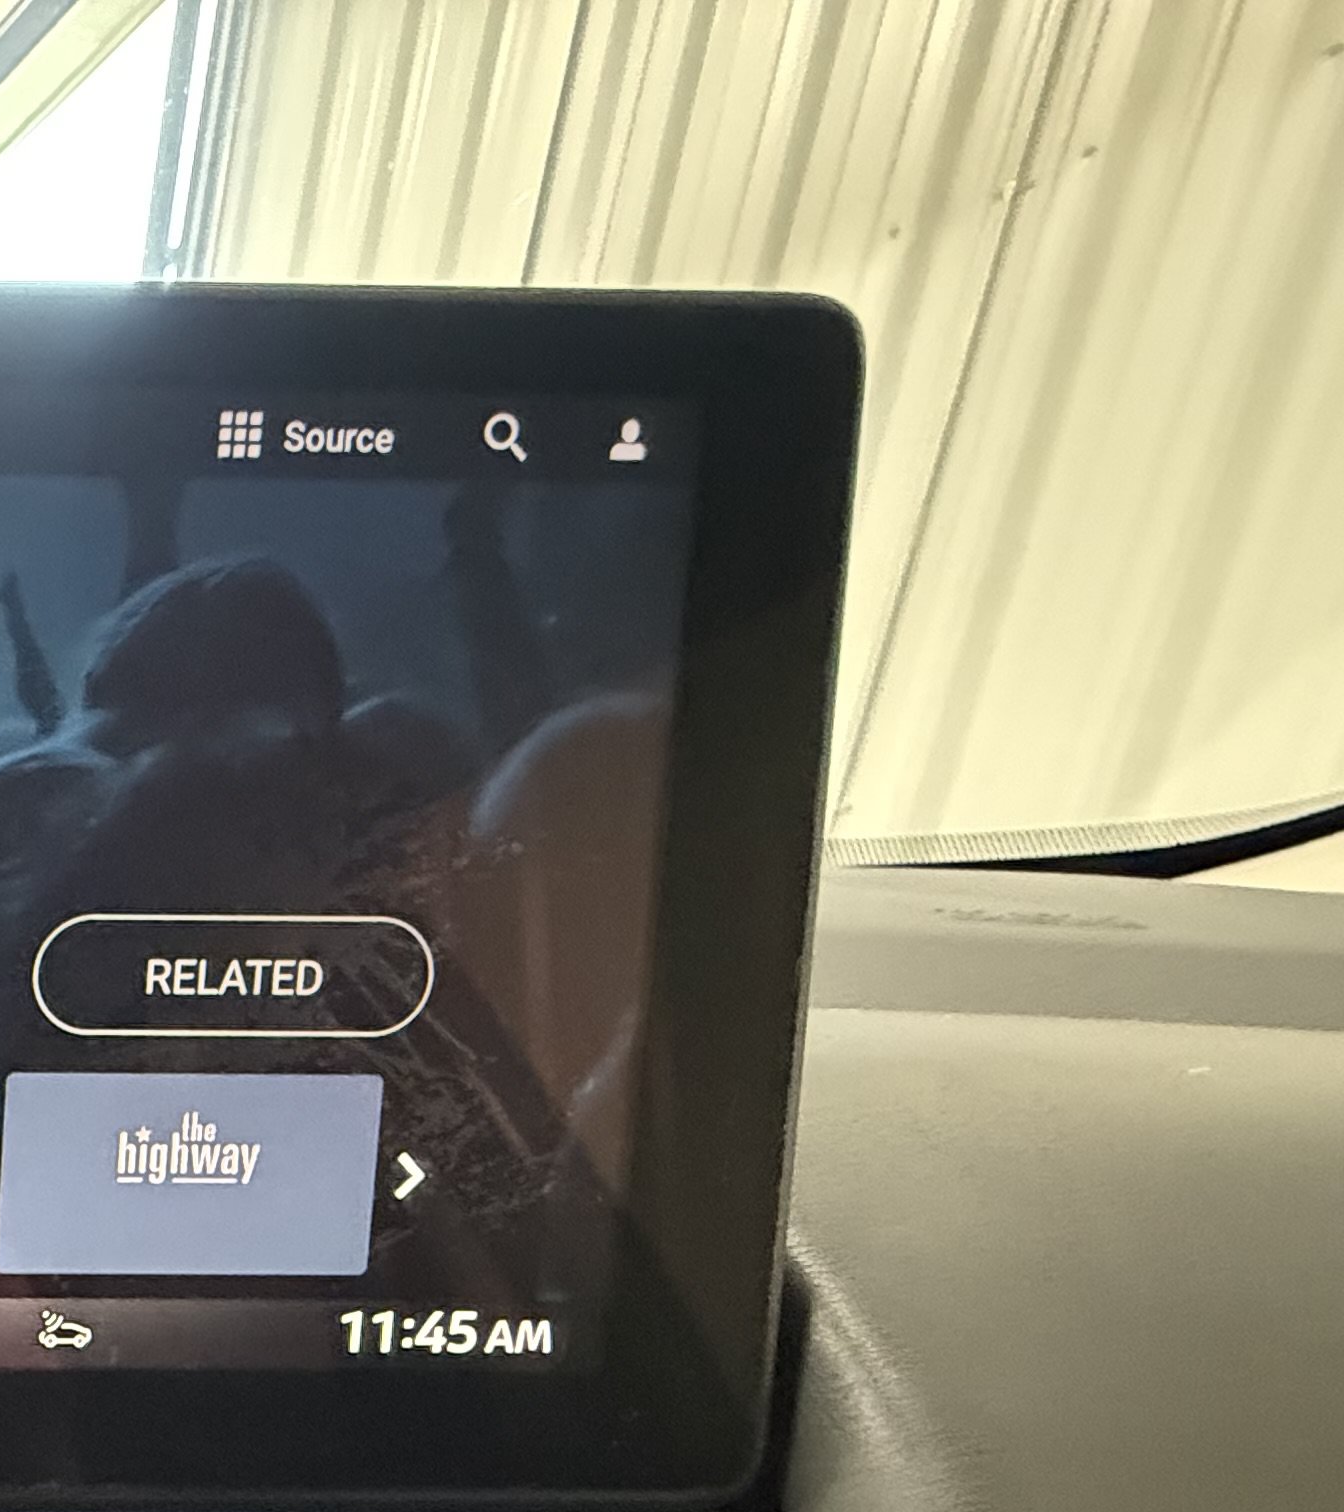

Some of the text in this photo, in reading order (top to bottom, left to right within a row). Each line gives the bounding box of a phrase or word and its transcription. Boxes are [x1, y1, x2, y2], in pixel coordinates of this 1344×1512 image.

[283, 420, 395, 454] Source
[143, 958, 324, 998] RELATED
[181, 1111, 217, 1142] the
[116, 1125, 261, 1185] highway
